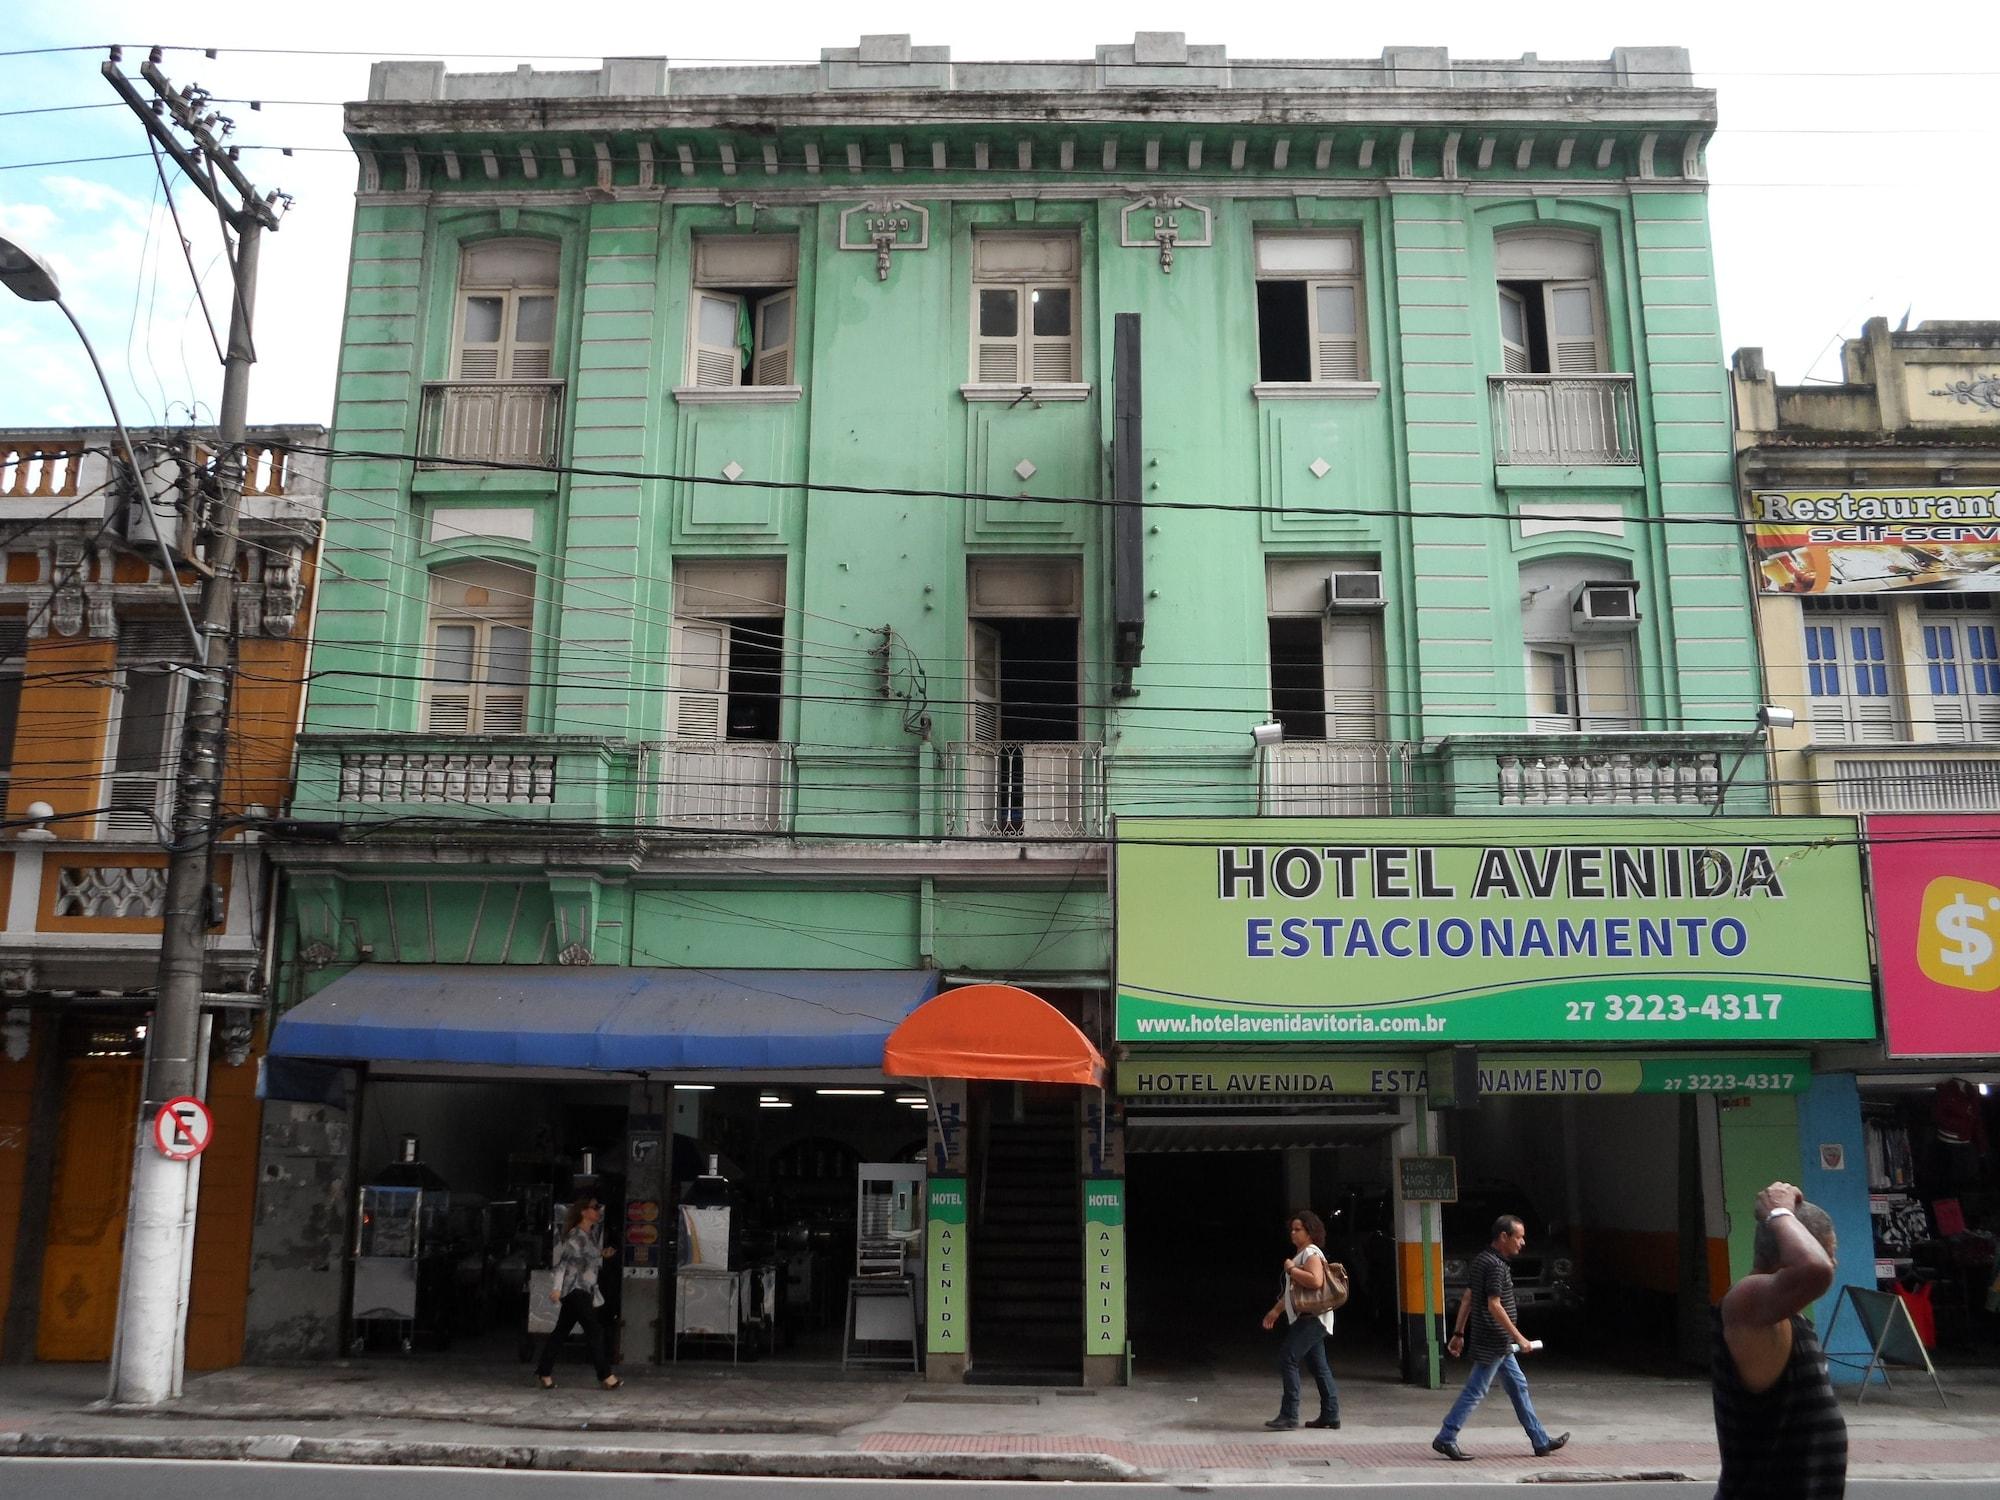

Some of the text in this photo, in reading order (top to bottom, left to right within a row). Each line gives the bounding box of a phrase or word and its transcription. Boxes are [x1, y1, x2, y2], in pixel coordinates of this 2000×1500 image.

[864, 217, 910, 232] 1929
[1218, 847, 1787, 899] HOTEL AVENIDA
[1246, 917, 1748, 958] ESTACIONAMENTO
[1565, 994, 1782, 1021] 27 3223-4317
[1137, 1014, 1447, 1033] www.hotelavenidavitoria.com.br
[1137, 1069, 1602, 1092] HOTEL AVENIDA ESTANAMENTO
[1664, 1074, 1794, 1090] 27 3223-4317
[173, 1110, 195, 1145] E
[932, 1194, 962, 1205] HOTEL
[1088, 1195, 1119, 1207] HOTEL
[941, 1230, 952, 1340] AVENIDA
[1099, 1232, 1110, 1342] AVENIDA
